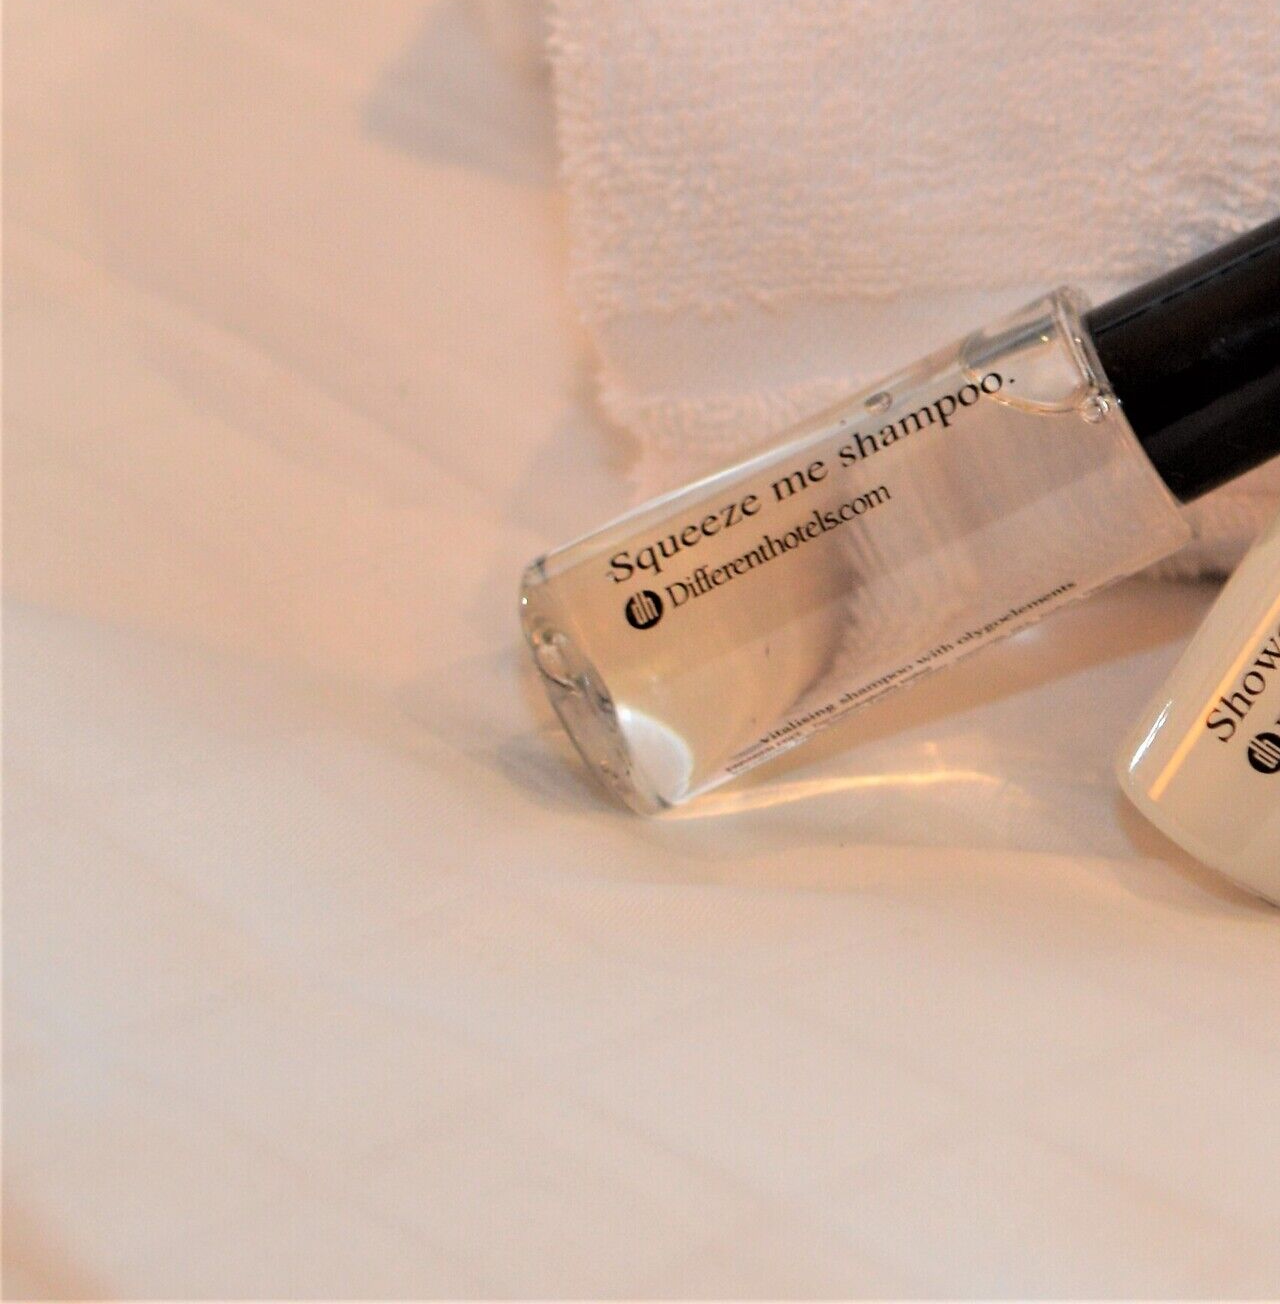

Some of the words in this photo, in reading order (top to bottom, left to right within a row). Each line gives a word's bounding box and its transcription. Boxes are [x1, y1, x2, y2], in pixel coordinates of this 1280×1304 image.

[609, 495, 760, 584] Squeeze
[771, 460, 829, 502] me
[838, 373, 1017, 469] shampoo.
[665, 486, 891, 608] Differenthotels.com
[839, 663, 914, 706] shampoo
[914, 641, 955, 666] with
